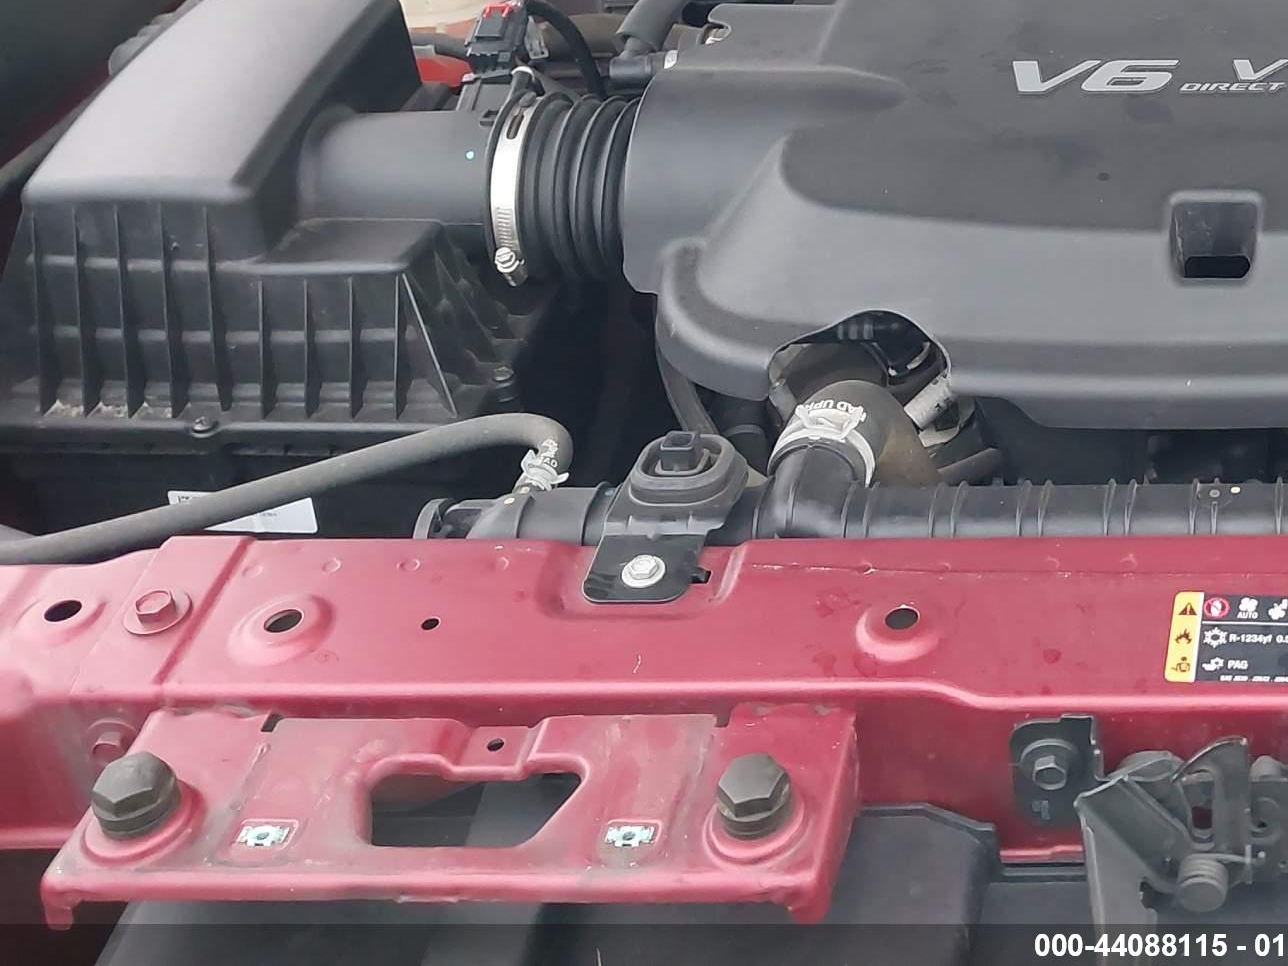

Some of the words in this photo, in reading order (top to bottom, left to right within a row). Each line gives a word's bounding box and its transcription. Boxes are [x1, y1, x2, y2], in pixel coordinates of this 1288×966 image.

[1012, 59, 1180, 93] V6
[1178, 82, 1286, 93] DIRECT
[1237, 611, 1259, 619] AUTO
[1229, 634, 1272, 645] R-1234yf
[1227, 660, 1249, 670] PAG
